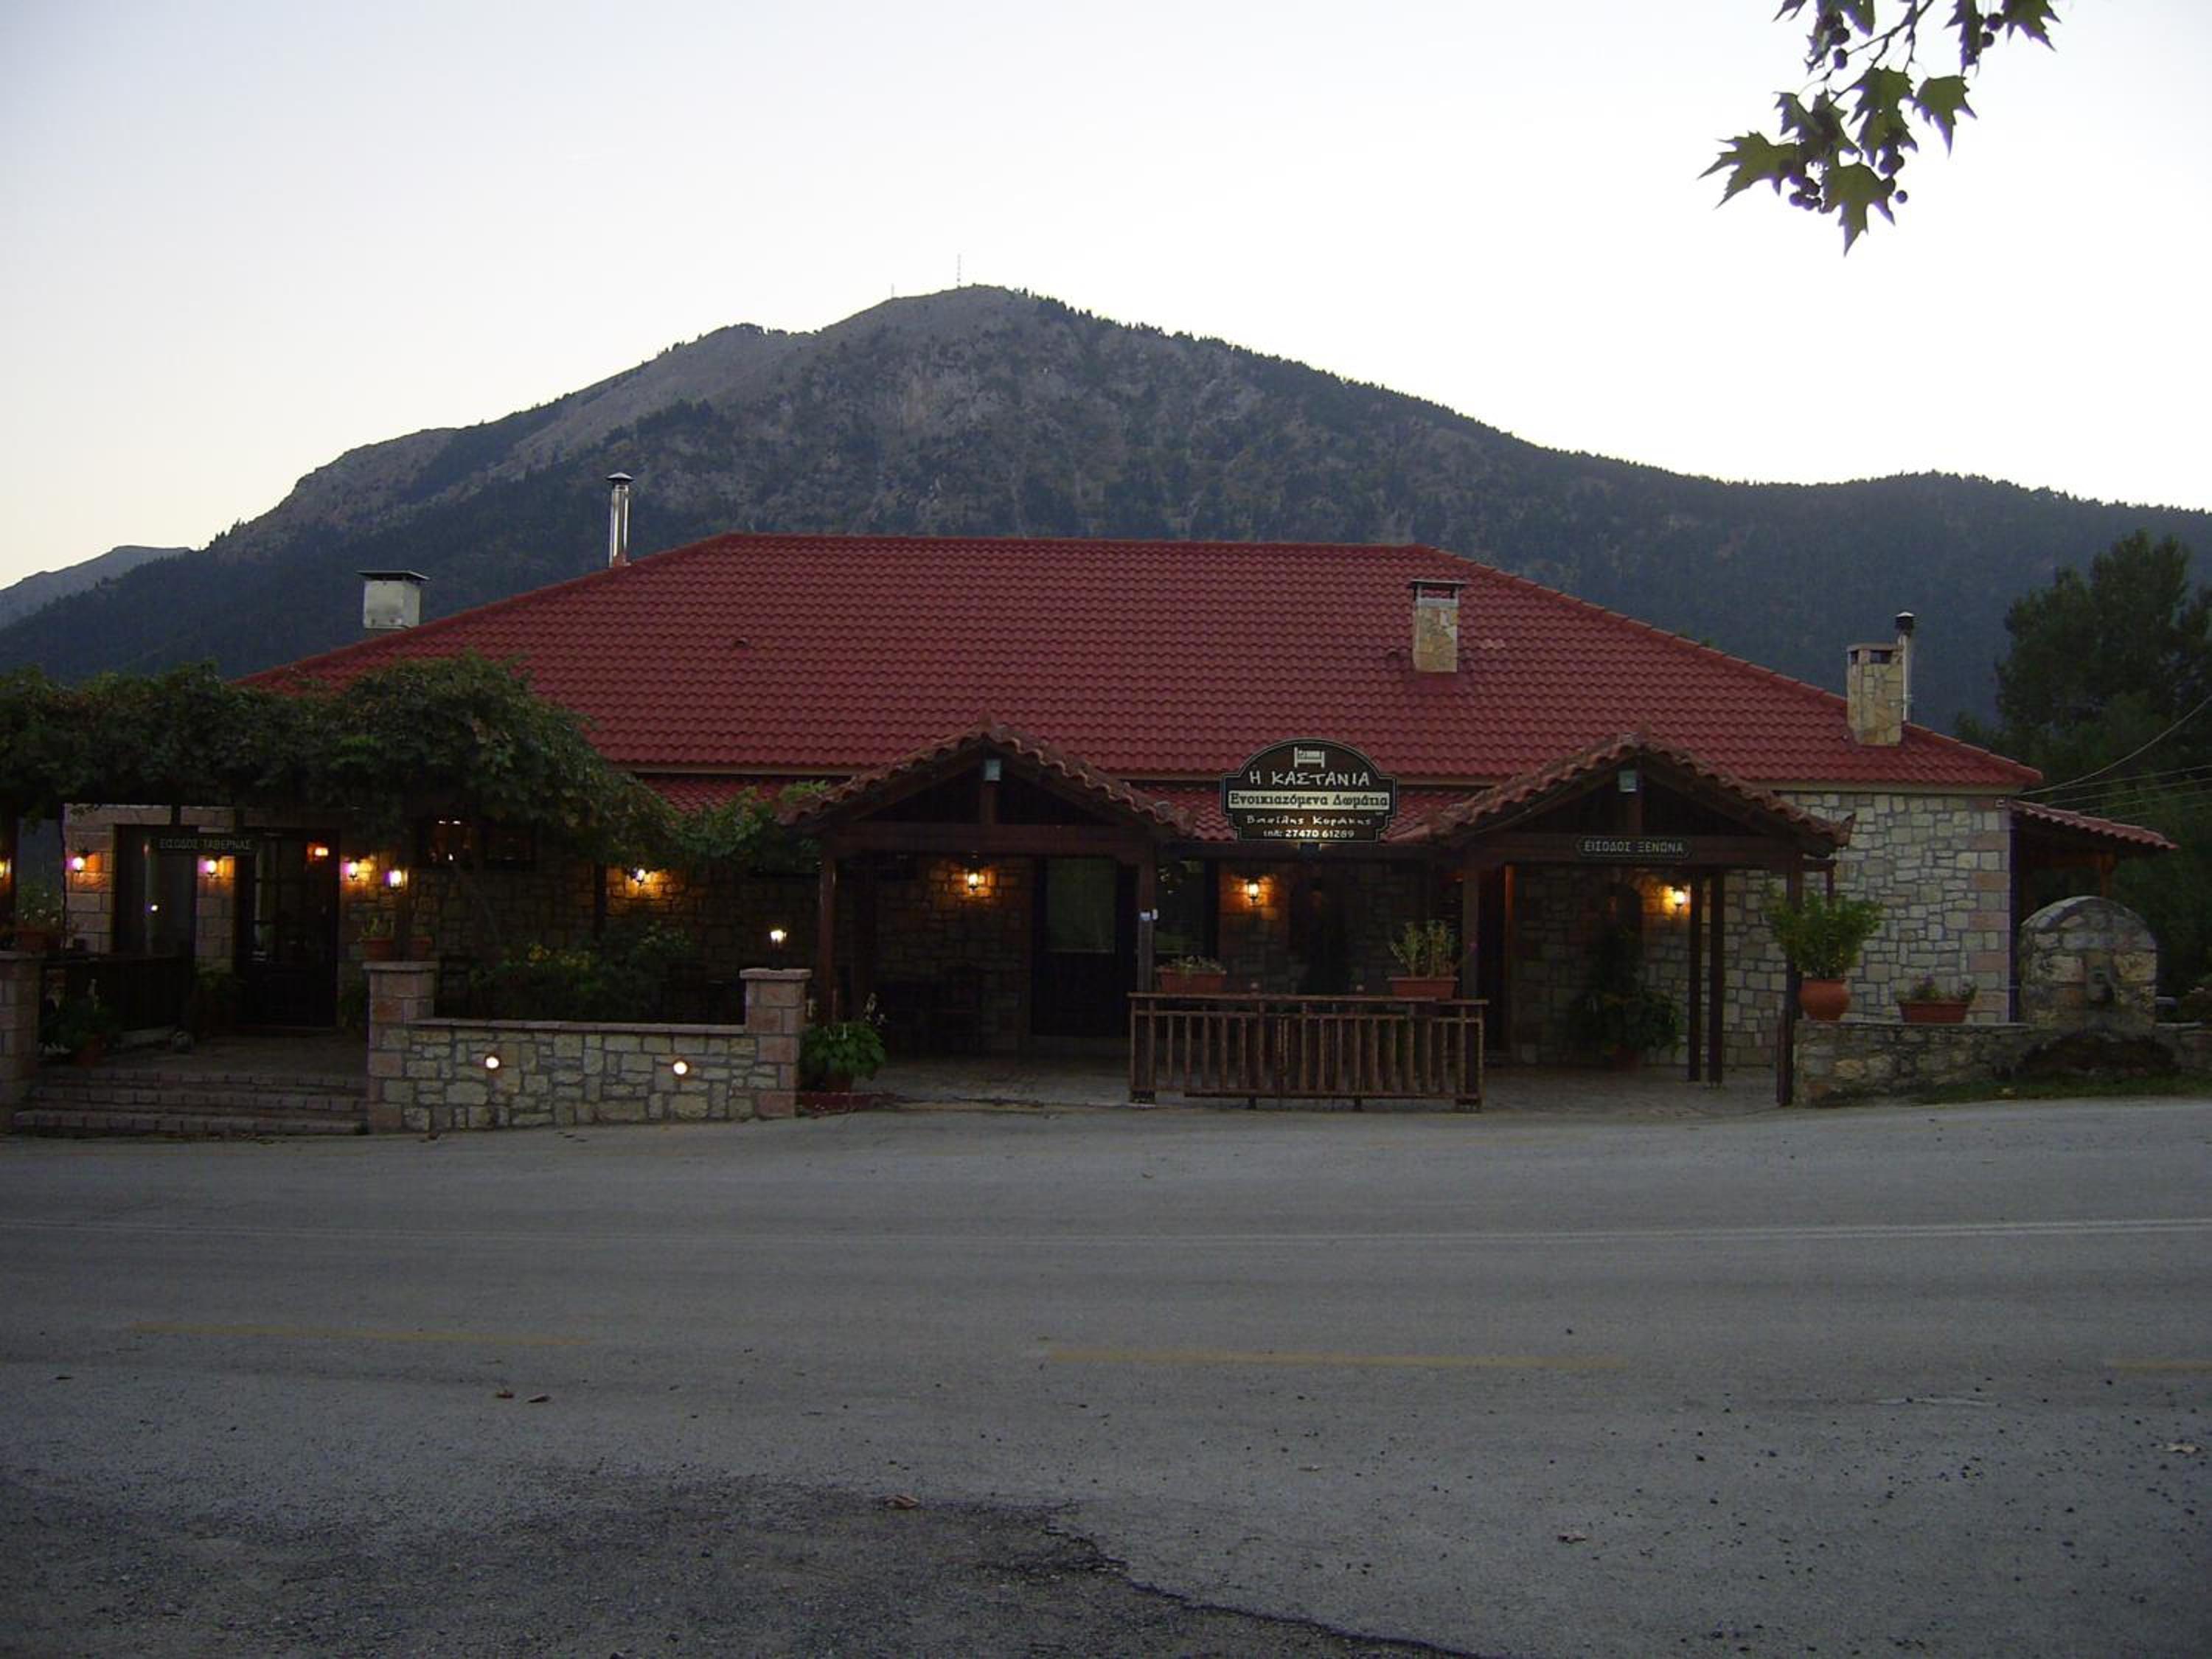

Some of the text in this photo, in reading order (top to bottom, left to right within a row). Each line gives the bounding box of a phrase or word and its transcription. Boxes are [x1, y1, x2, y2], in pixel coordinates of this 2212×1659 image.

[1272, 771, 1370, 786] ΚΑΣΤΑΝΙΑ
[1231, 793, 1388, 808] Ενοικιαζόμενα Δωμάτια
[1285, 830, 1319, 838] 27470
